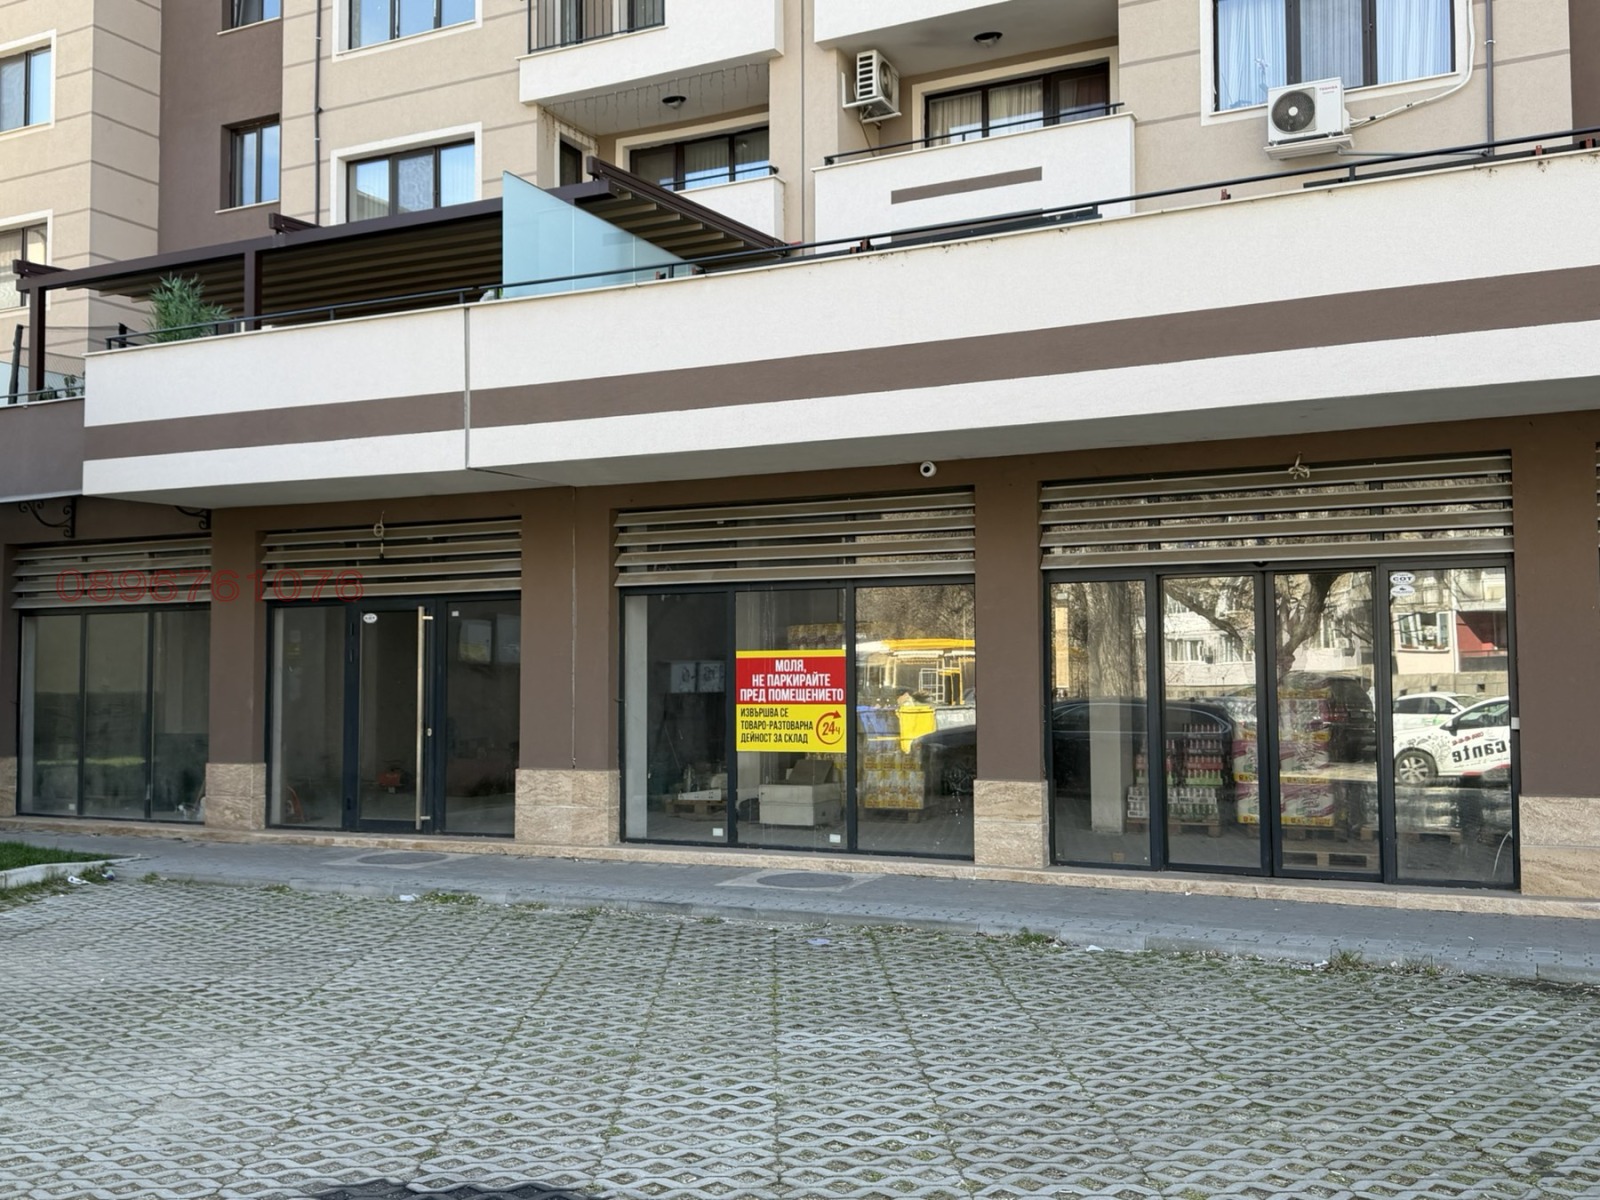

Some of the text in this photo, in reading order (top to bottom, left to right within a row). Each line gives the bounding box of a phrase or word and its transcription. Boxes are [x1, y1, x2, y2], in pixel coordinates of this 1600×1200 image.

[775, 659, 807, 673] МОЛЯ,
[752, 671, 831, 687] НЕ ПАРКИРАЙТЕ
[740, 688, 844, 703] ПРЕД ПОМЕЩЕНИЕТО
[740, 707, 789, 718] ИЗВЪРШВА СЕ
[740, 720, 814, 731] ТОВАРО-РАЗТОВАРНА
[740, 732, 808, 744] ДЕЙНОСТ ЗА СКЛАД
